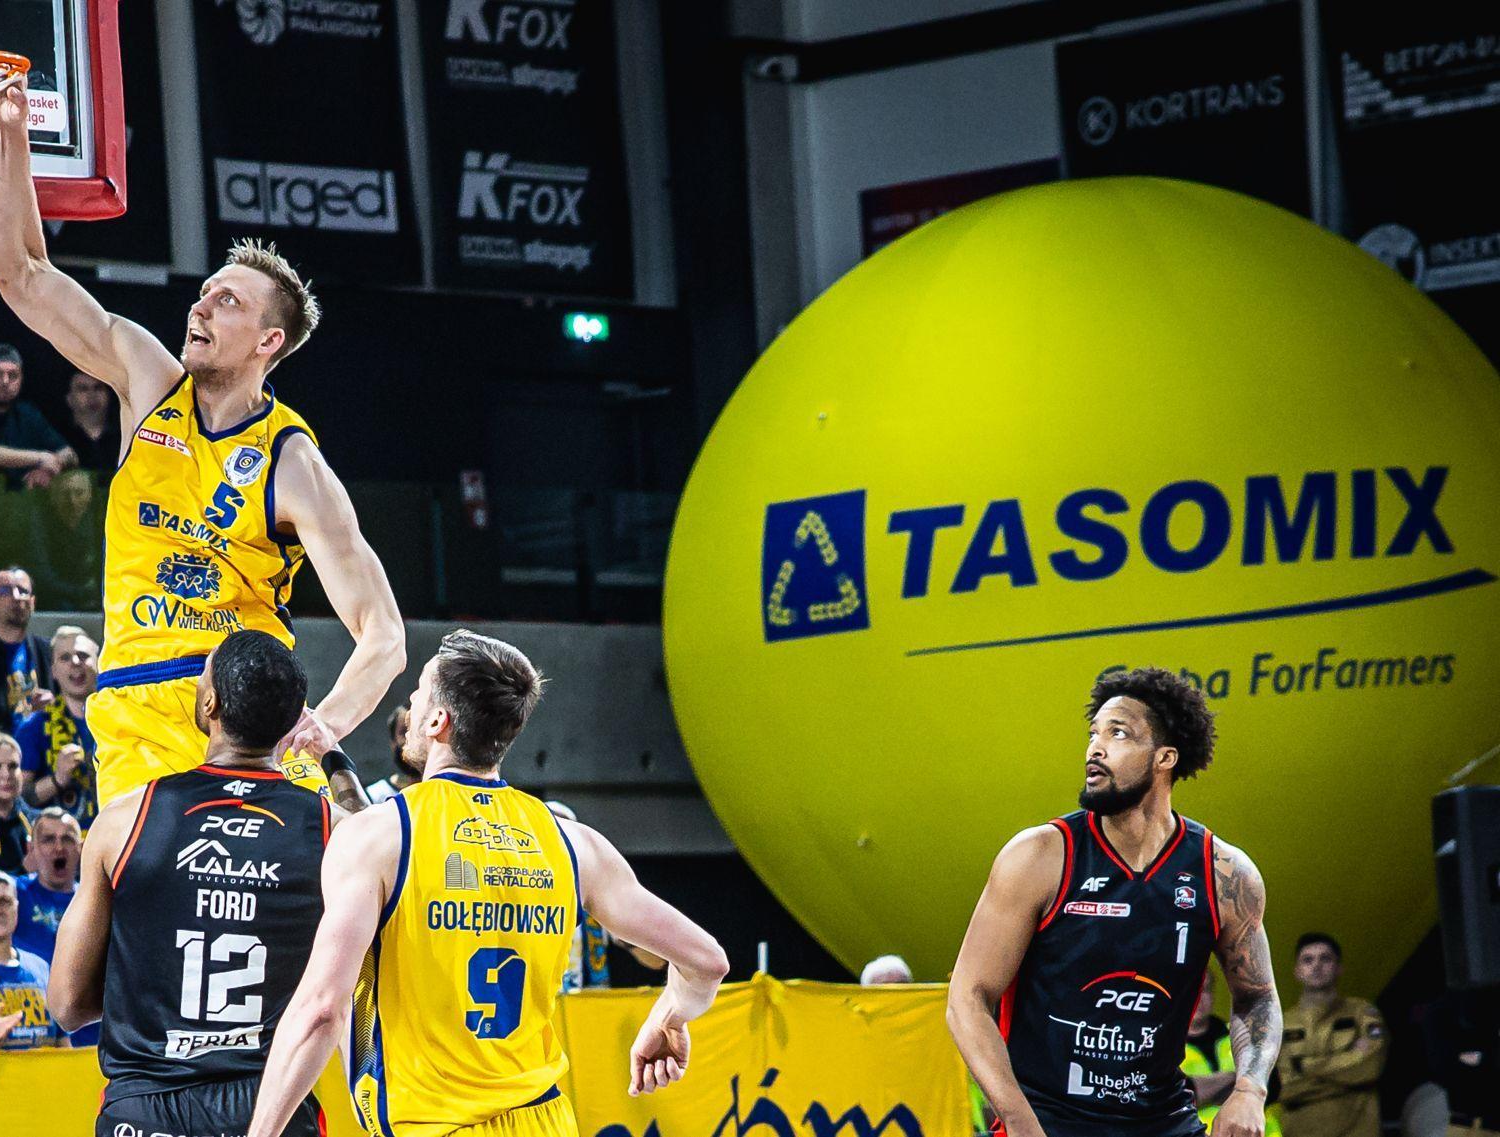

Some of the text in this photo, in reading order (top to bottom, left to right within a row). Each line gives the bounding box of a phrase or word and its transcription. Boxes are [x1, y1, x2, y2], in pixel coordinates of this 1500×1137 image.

[28, 95, 59, 110] asket
[1125, 75, 1285, 128] KORTRANS
[27, 113, 45, 125] iga
[226, 168, 388, 228] arged
[139, 429, 165, 443] ORLEN
[205, 481, 246, 529] 5
[887, 465, 1456, 600] TASOMIX
[1249, 647, 1455, 696] ForFarmers
[200, 815, 265, 838] PGE
[189, 857, 282, 881] LALAK
[483, 866, 553, 878] VIPCOSTABLANCA
[189, 874, 280, 889] DEVELOPMENT
[483, 875, 554, 890] RENTAL.COM
[196, 888, 257, 921] FORD
[428, 900, 565, 937] GOŁĘBIOWSKI
[1176, 921, 1189, 964] 1
[175, 929, 267, 1023] 12
[465, 947, 527, 1040] 9
[1095, 989, 1155, 1012] PGE
[175, 1033, 249, 1053] PERŁA
[1073, 1049, 1109, 1060] MIASTO
